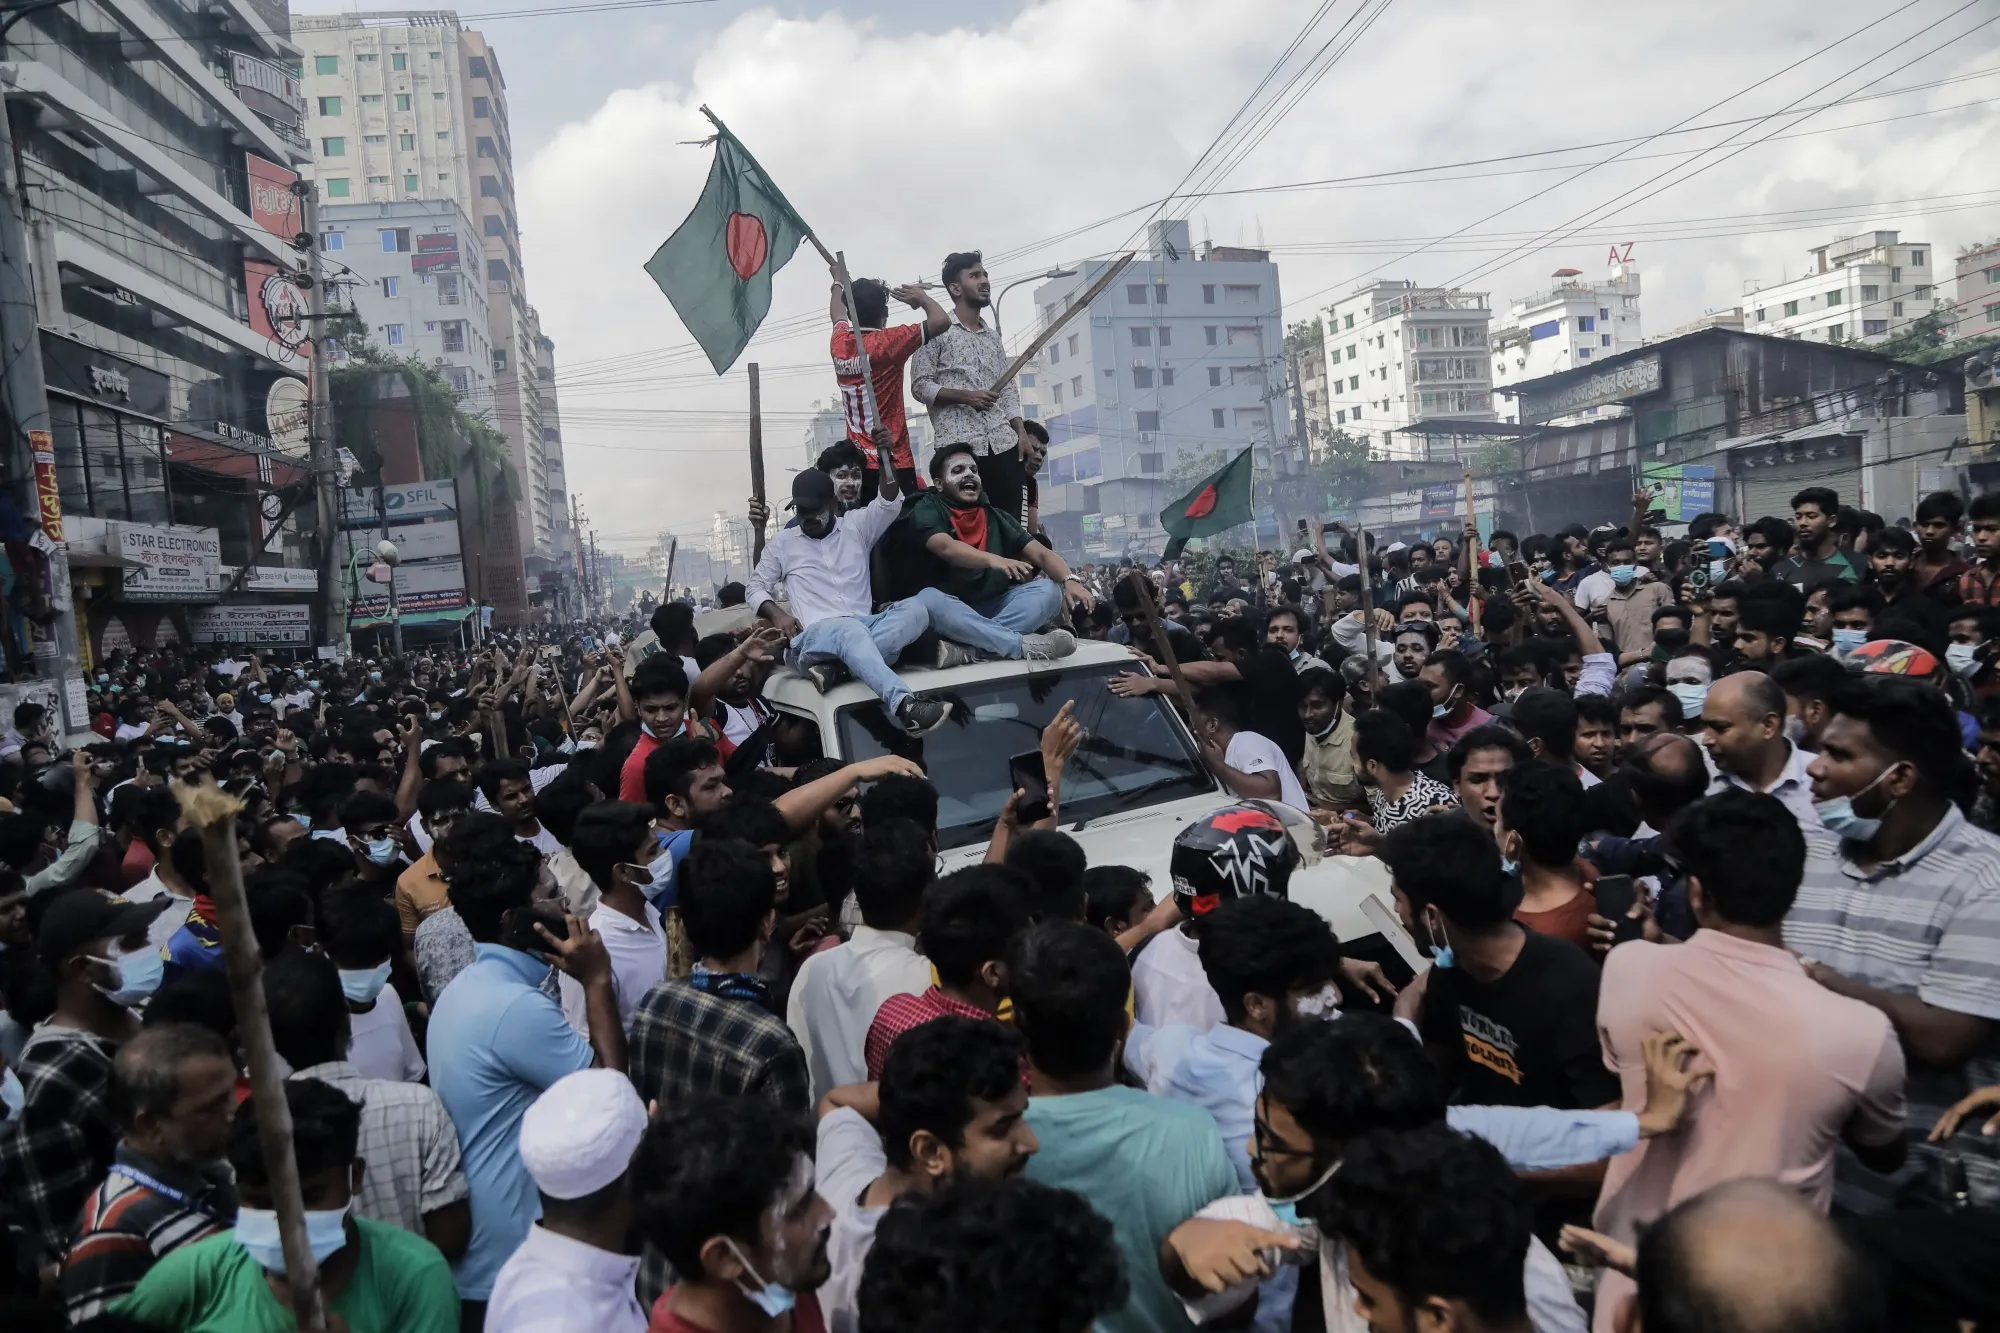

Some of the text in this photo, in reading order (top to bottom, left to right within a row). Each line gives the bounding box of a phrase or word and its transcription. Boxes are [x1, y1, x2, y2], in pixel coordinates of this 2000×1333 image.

[1608, 242, 1635, 266] AZ
[407, 489, 437, 503] SFIL
[129, 533, 218, 553] STAR ELECTRONICS
